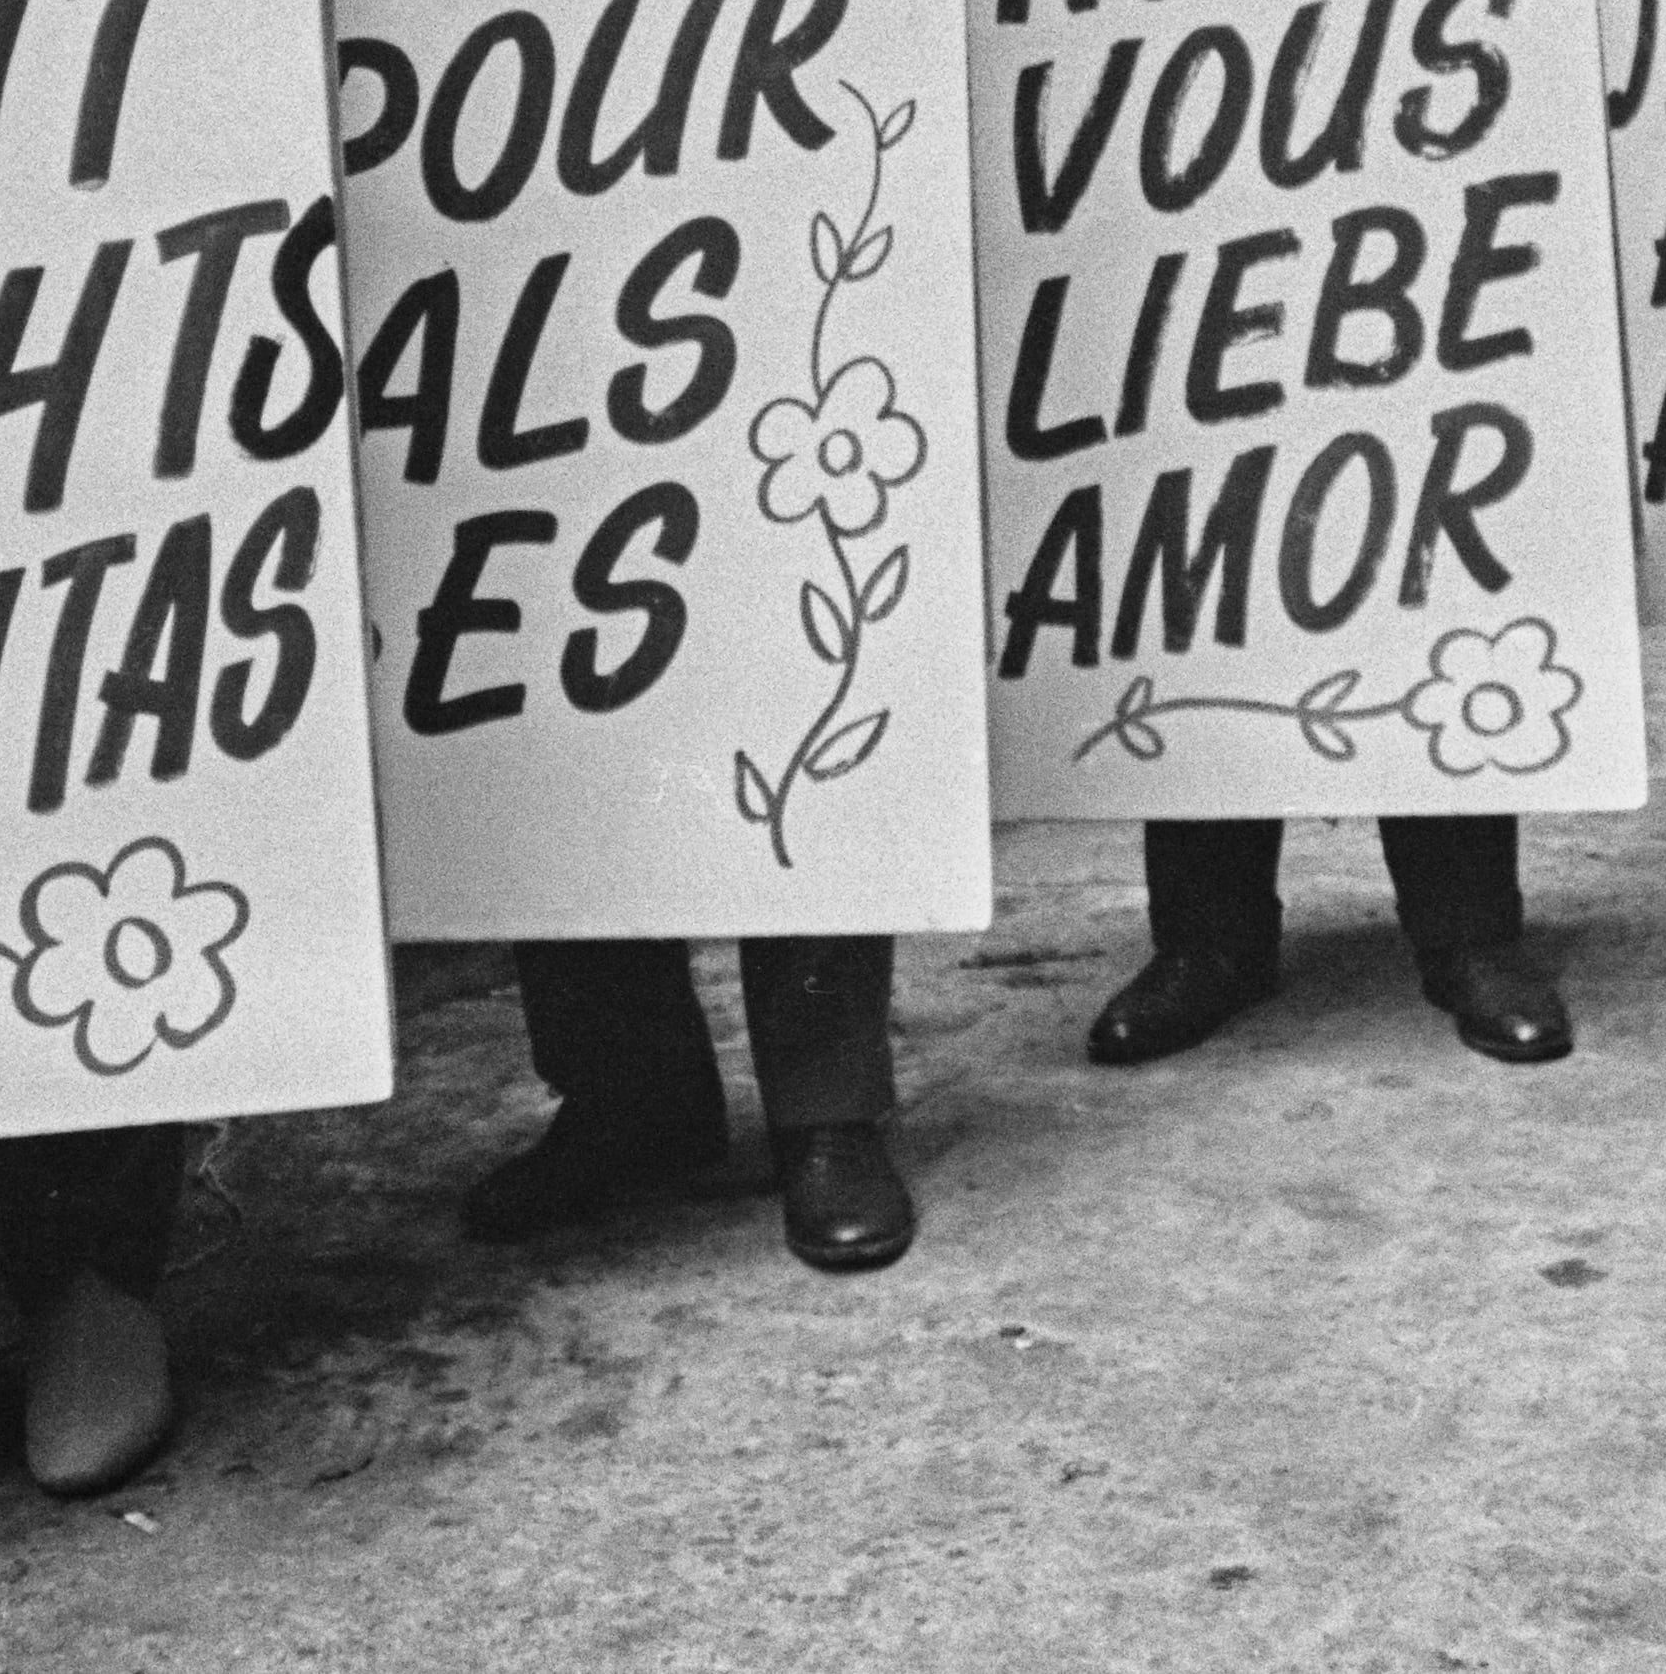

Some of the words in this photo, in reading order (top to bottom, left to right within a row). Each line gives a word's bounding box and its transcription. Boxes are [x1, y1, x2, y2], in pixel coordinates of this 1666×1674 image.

[356, 216, 740, 484] ALS
[1005, 172, 1559, 463] LIEBE
[402, 481, 699, 738] ES
[996, 403, 1531, 682] AMOR
